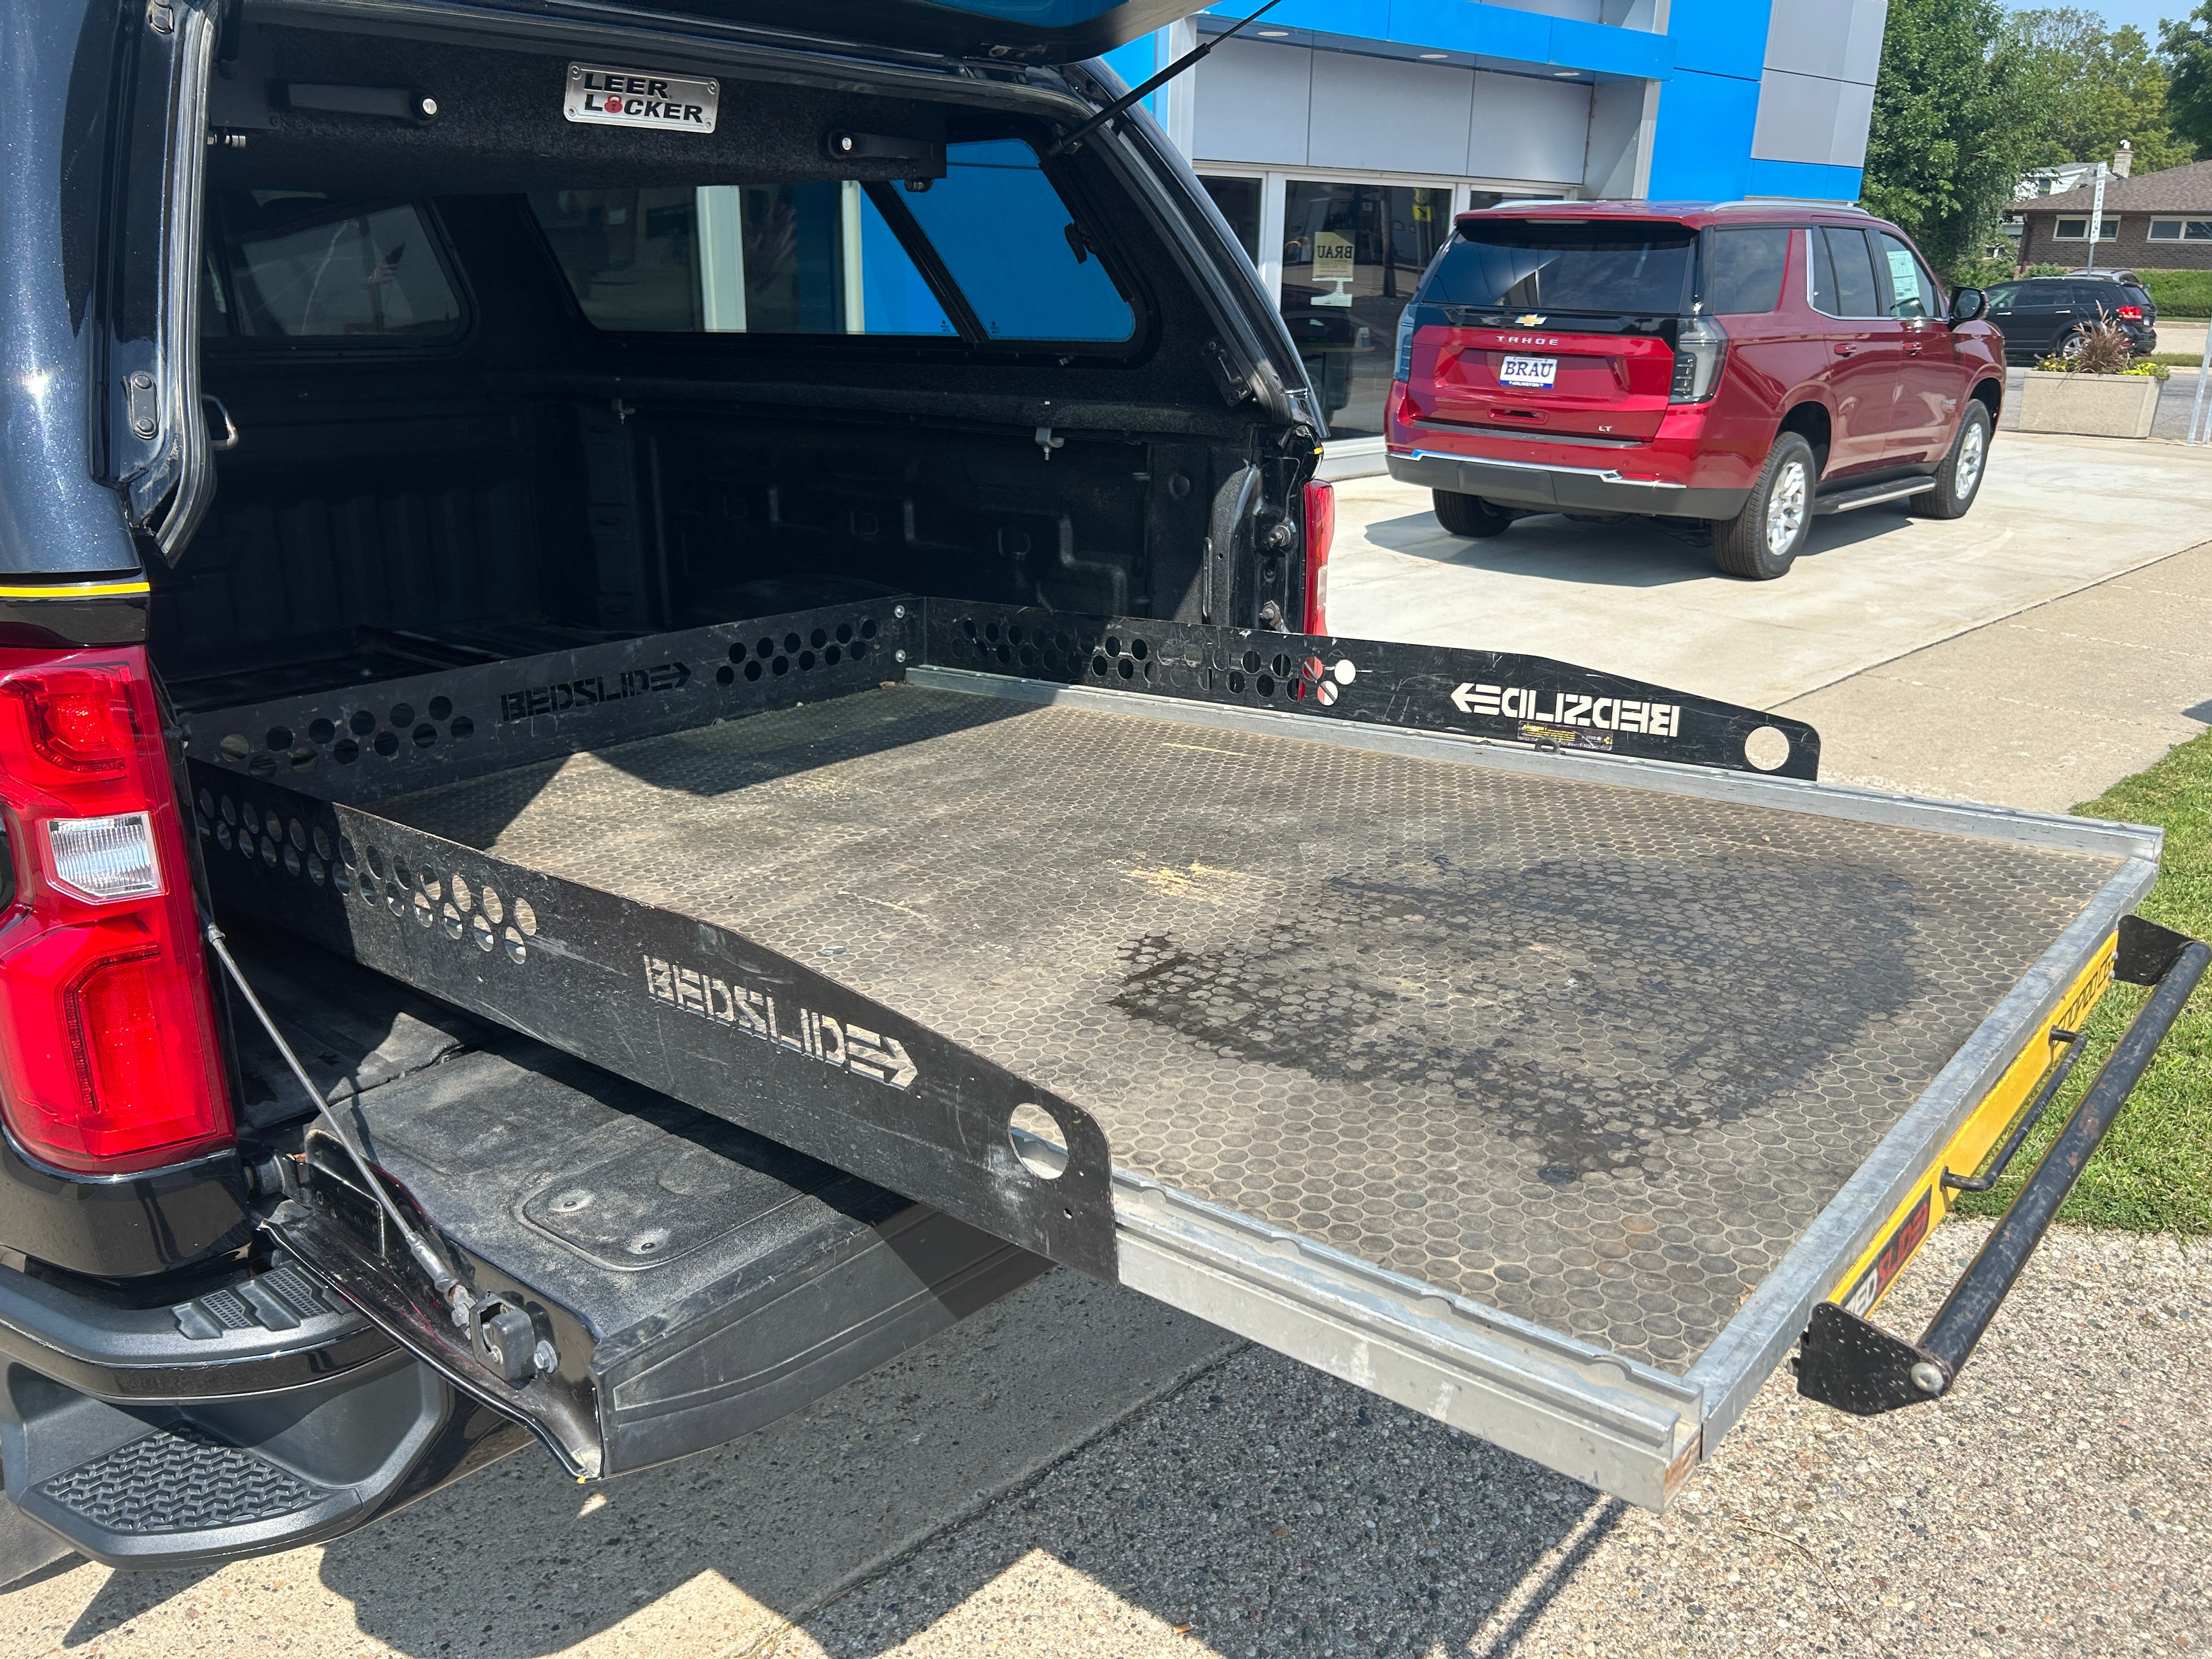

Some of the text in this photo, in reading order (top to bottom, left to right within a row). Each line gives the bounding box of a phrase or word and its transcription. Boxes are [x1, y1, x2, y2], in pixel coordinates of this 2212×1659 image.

[584, 73, 669, 99] LEER
[1496, 335, 1559, 346] TAHOE
[1504, 360, 1554, 377] BRAU
[500, 662, 692, 721] BEDSLIDE
[642, 953, 918, 1091] BEDSLIDE
